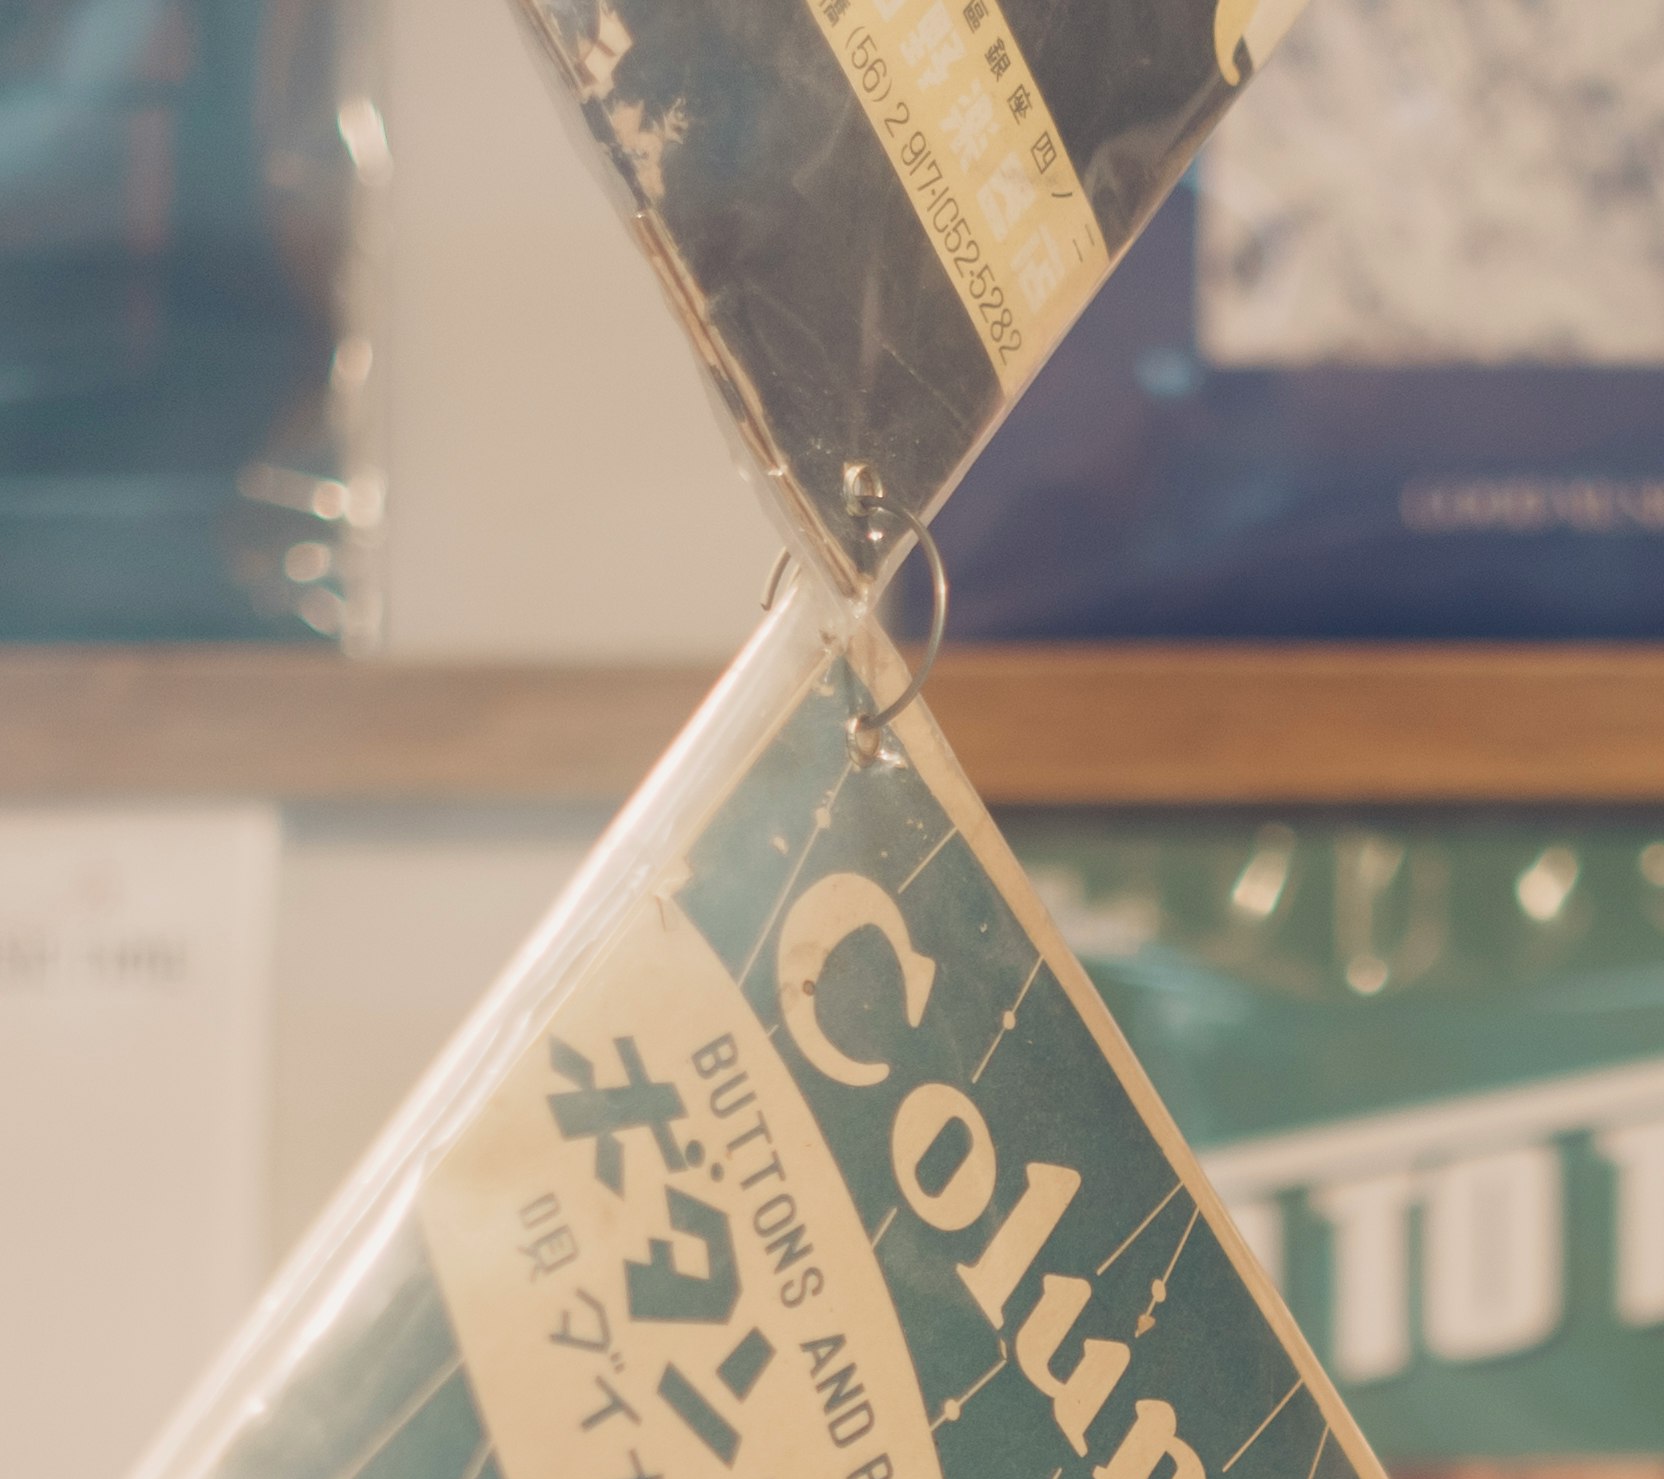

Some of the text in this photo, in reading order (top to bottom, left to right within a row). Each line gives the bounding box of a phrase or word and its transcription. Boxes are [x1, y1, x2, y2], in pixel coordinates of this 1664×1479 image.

[690, 1032, 824, 1309] BUTTONS
[799, 1334, 876, 1449] AND
[1309, 1147, 1564, 1386] TO
